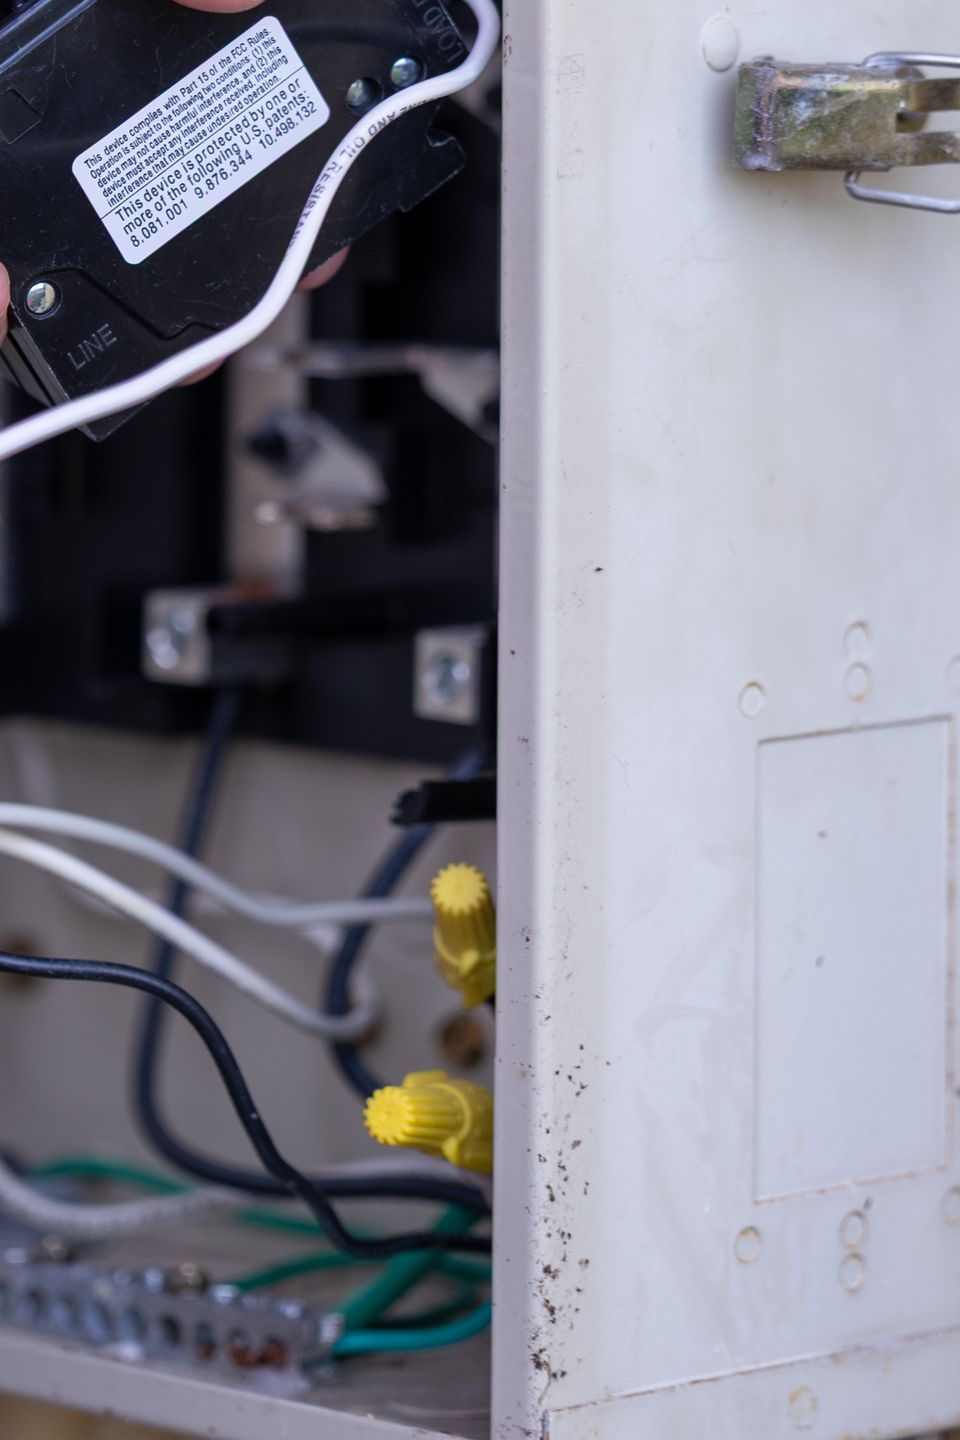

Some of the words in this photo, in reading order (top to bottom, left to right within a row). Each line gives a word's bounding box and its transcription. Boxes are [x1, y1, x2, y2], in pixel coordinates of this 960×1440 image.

[423, 6, 464, 63] LOAD
[83, 153, 103, 169] This
[103, 133, 129, 156] device
[128, 108, 163, 137] complies
[162, 94, 181, 110] with
[179, 80, 198, 98] Part
[197, 71, 209, 84] 15
[208, 63, 218, 76] of
[218, 55, 232, 69] the
[230, 42, 248, 59] FCC
[89, 151, 124, 179] Operation
[120, 146, 131, 155] is
[129, 126, 155, 150] subject
[152, 122, 162, 132] to
[160, 114, 173, 126] the
[171, 91, 204, 117] following
[201, 81, 216, 95] two
[251, 45, 264, 59] (1)
[261, 36, 276, 50] this
[97, 166, 122, 188] device
[120, 154, 137, 171] may
[136, 144, 150, 159] not
[148, 129, 171, 149] cause
[168, 107, 199, 133] harmful
[241, 63, 257, 80] and
[255, 55, 268, 70] (2)
[266, 46, 282, 60] this
[102, 176, 127, 198] device
[125, 161, 146, 180] must
[143, 143, 170, 167] accept
[168, 134, 182, 149] any
[180, 103, 224, 138] interference
[254, 54, 288, 83] including
[106, 169, 154, 208] interference
[151, 156, 169, 174] that
[167, 145, 185, 162] may
[184, 129, 208, 150] cause
[206, 100, 244, 133] undesired
[114, 198, 143, 221] This
[143, 169, 182, 202] device
[180, 159, 195, 173] is
[194, 115, 250, 167] protected
[248, 105, 265, 122] by
[265, 90, 287, 111] one
[287, 78, 300, 93] or
[122, 208, 153, 235] more
[153, 194, 167, 212] of
[166, 182, 188, 201] the
[186, 142, 241, 186] following
[239, 124, 265, 145] U.S.
[264, 90, 309, 130] patents:
[339, 136, 365, 158] OIL
[368, 111, 397, 137] AND
[67, 323, 117, 370] LINE
